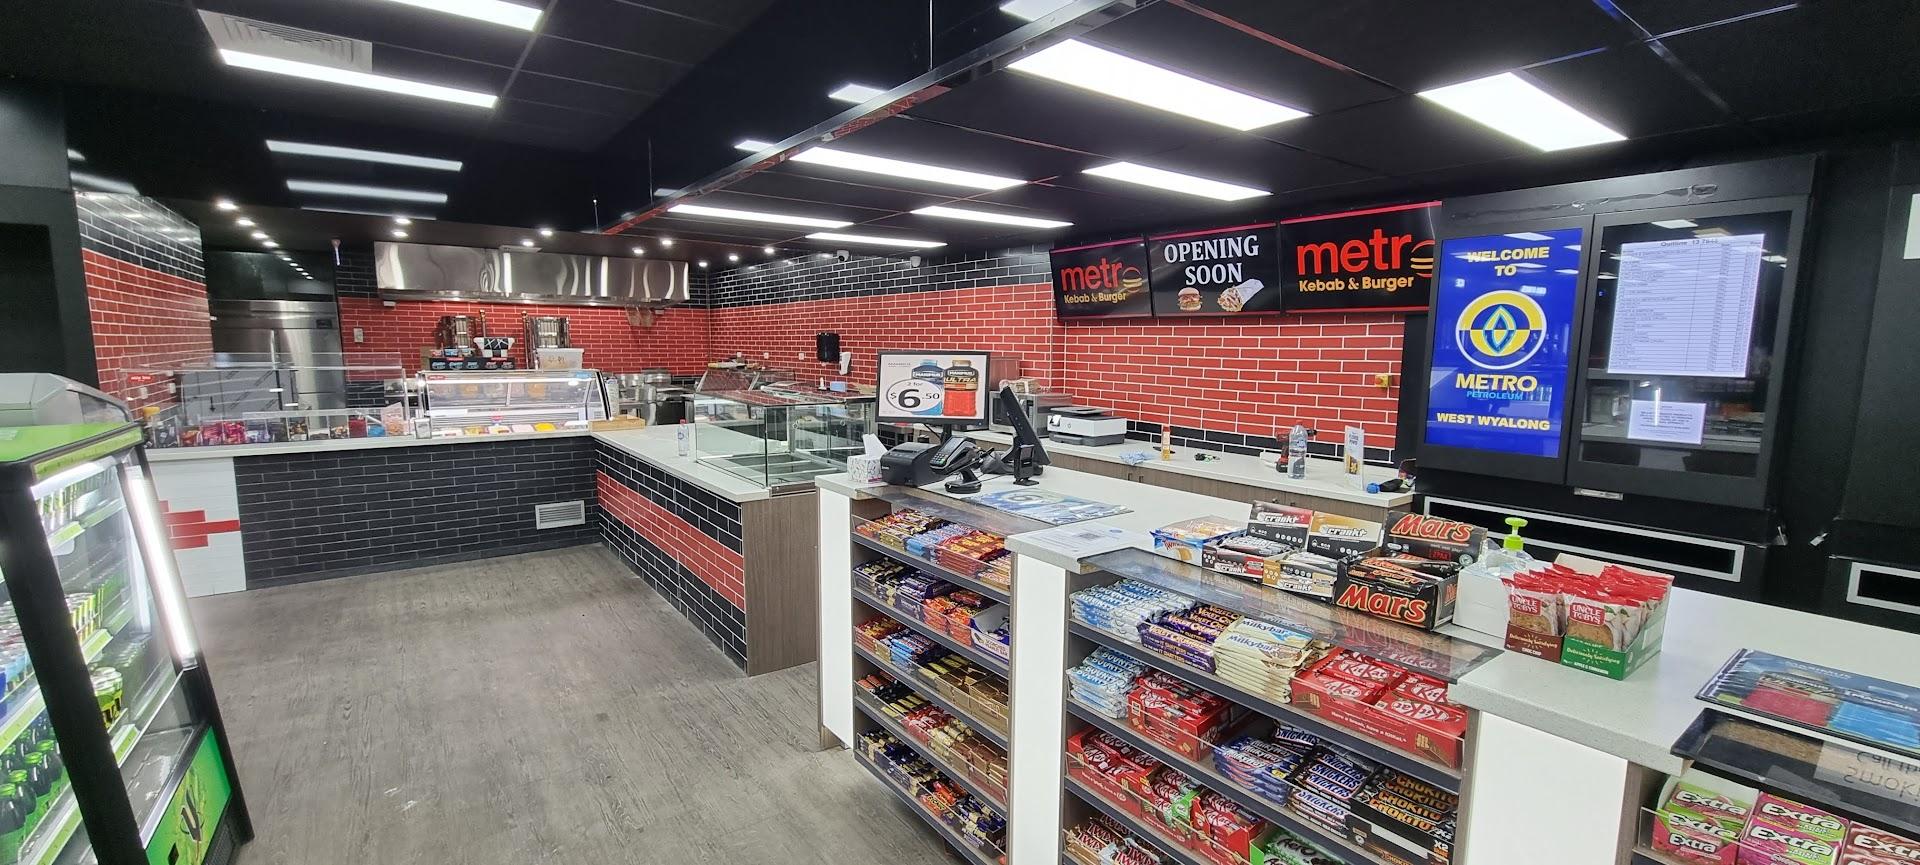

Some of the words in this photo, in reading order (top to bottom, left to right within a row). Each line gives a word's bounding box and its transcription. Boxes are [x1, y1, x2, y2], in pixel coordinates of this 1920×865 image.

[1164, 235, 1260, 263] OPENING
[1467, 247, 1550, 263] WELCOME
[1184, 262, 1243, 286] SOON
[1494, 265, 1517, 277] TO
[1299, 278, 1346, 292] Kebab
[1347, 277, 1360, 290] &
[1362, 275, 1414, 293] Burger
[1063, 293, 1089, 304] Kebab
[1090, 293, 1098, 302] &
[1098, 291, 1127, 304] Burger
[1456, 373, 1538, 392] METRO
[1466, 390, 1524, 401] PETROLEUM
[1436, 412, 1474, 425] WEST
[1478, 415, 1550, 430] WYALONG
[1390, 514, 1473, 541] Mars
[1336, 584, 1428, 623] Mars
[1511, 595, 1537, 606] UNCLE
[1513, 603, 1538, 613] TOBYS
[1572, 604, 1601, 616] UNCLE
[1242, 617, 1288, 635] Milkybar
[1573, 611, 1601, 625] TOBYS
[1227, 633, 1275, 652] Milkybar
[1101, 651, 1136, 670] BOUNTY
[1310, 763, 1360, 789] SNICKERS
[1378, 790, 1442, 821] CHOKITO
[1675, 790, 1748, 816] Extra
[1368, 798, 1435, 831] CHOKITO
[1761, 802, 1844, 831] Extra
[1668, 812, 1741, 840] Extra
[1669, 833, 1718, 853] Extra
[1750, 826, 1835, 857] Extra
[1853, 834, 1920, 861] Extr
